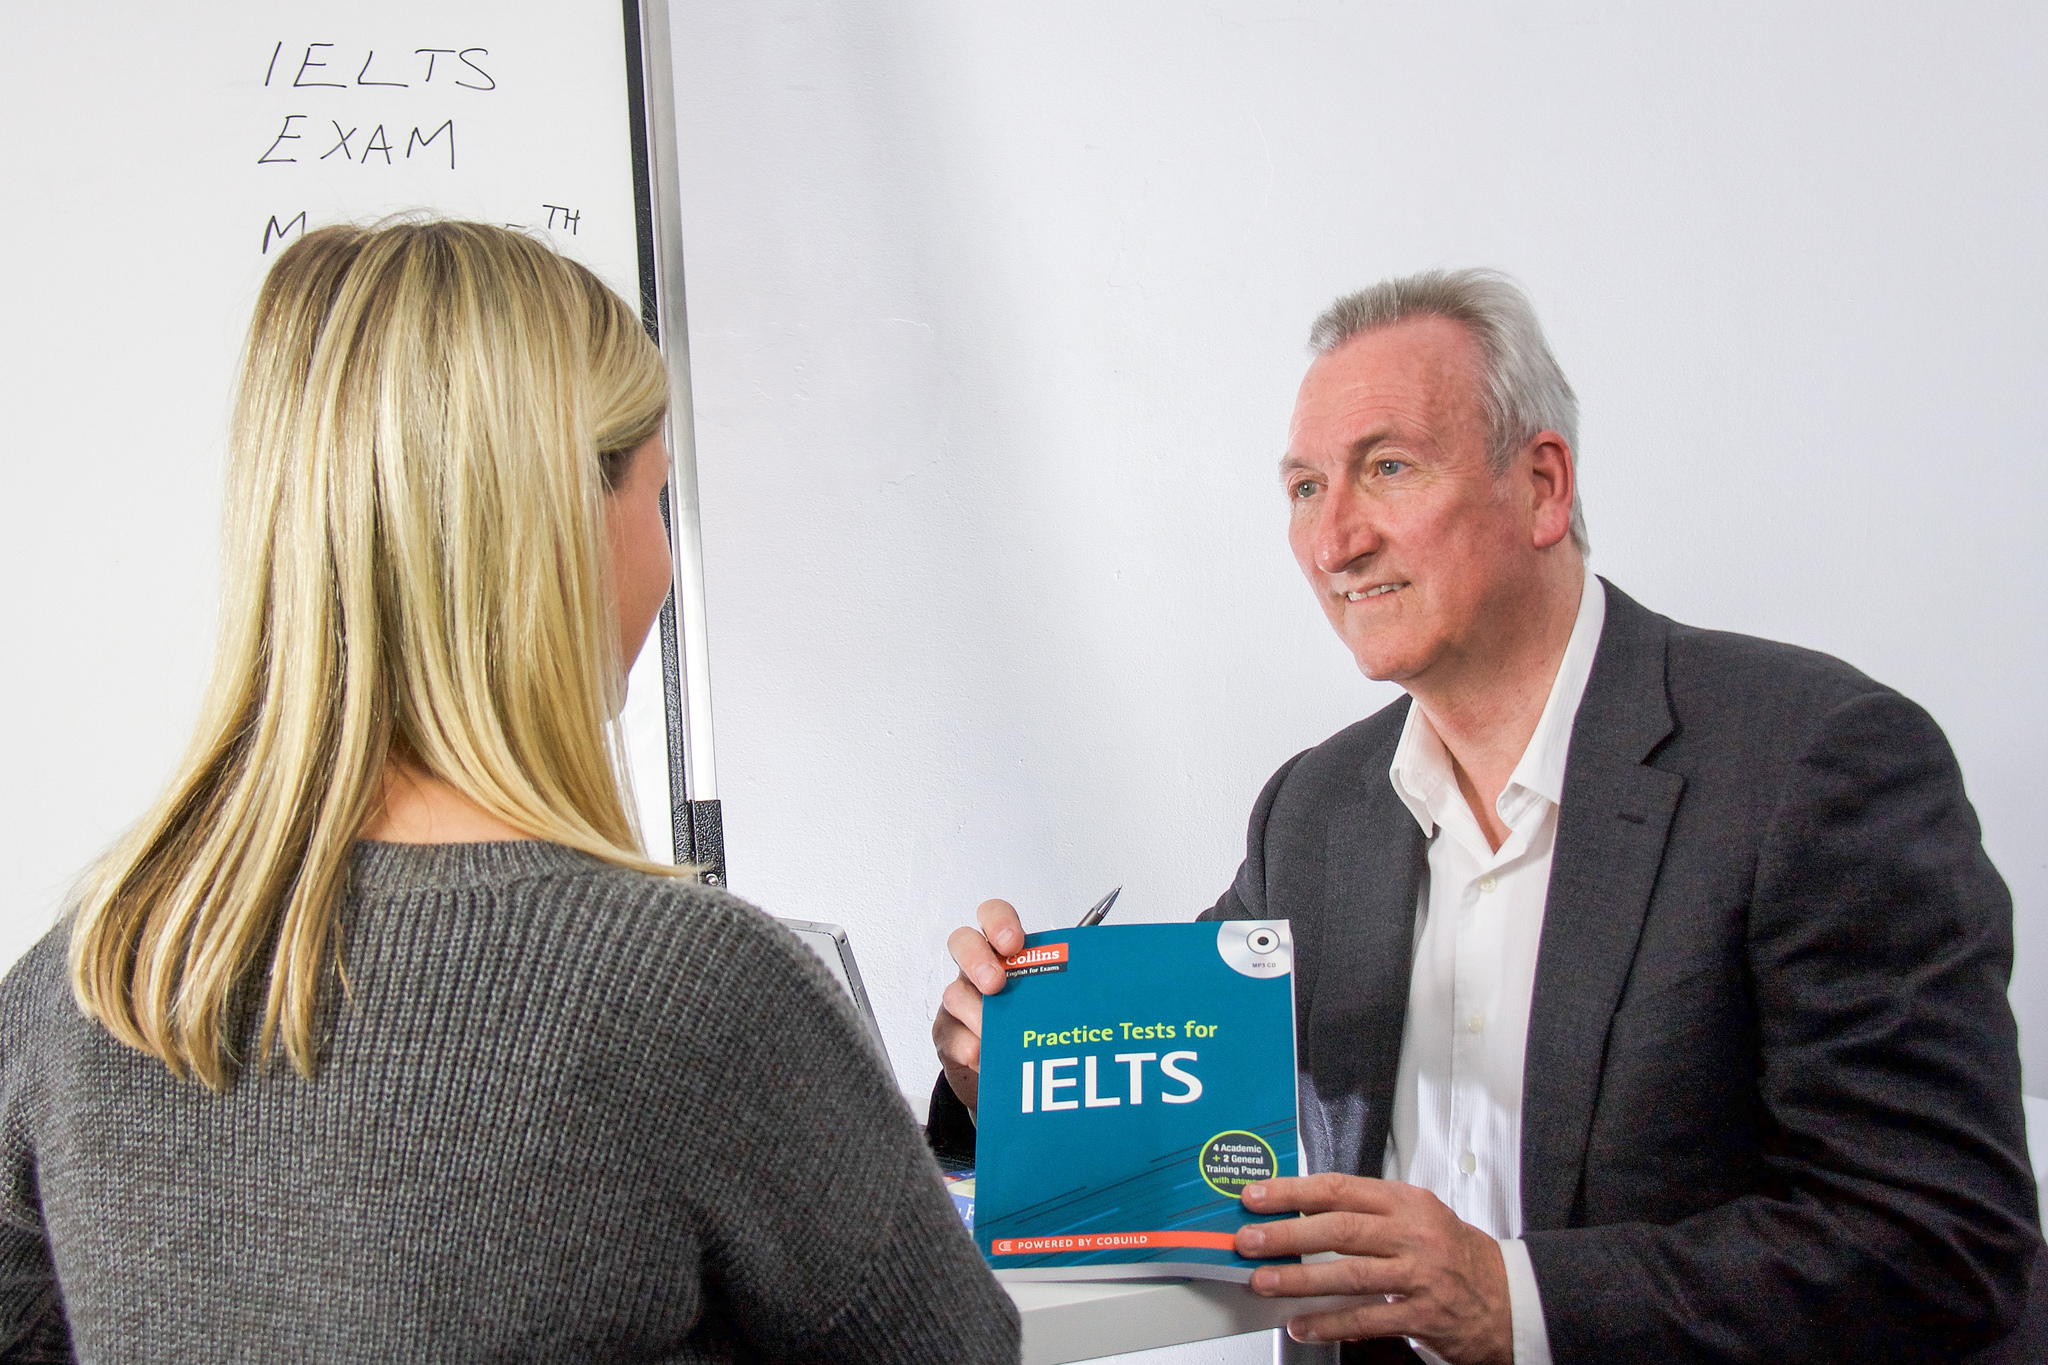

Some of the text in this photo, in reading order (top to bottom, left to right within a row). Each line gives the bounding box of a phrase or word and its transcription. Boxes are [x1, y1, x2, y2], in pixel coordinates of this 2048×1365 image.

[265, 41, 496, 91] IELTS
[258, 115, 456, 170] EXAM
[1006, 950, 1060, 966] Collins
[1023, 1020, 1218, 1048] Practice Tests for
[1021, 1050, 1203, 1114] IELTS
[1213, 1144, 1262, 1153] 4 Academic
[1223, 1154, 1230, 1163] 2
[1231, 1155, 1264, 1164] General
[1206, 1164, 1270, 1176] Training Papers
[1212, 1176, 1230, 1184] with
[1018, 1235, 1148, 1250] POWERED BY COBUILD
